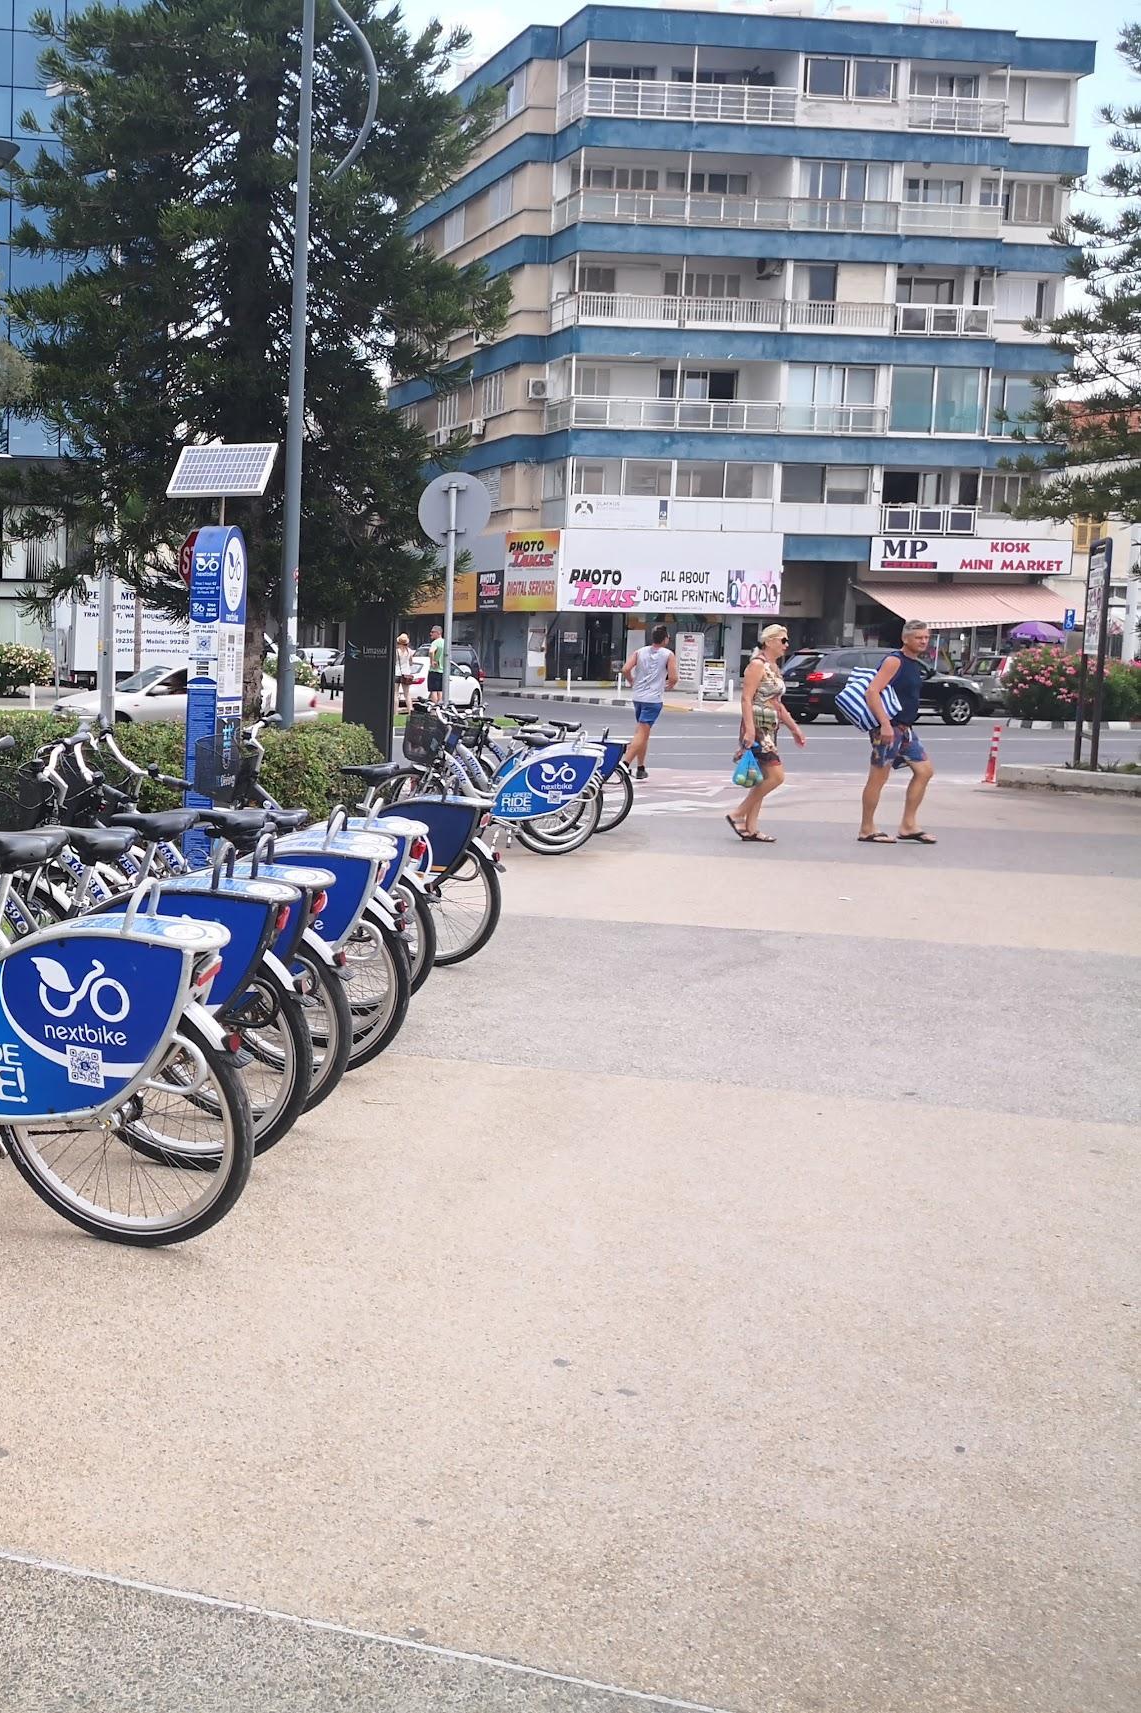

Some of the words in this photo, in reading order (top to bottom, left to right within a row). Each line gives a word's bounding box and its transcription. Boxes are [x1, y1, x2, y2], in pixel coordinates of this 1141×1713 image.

[509, 540, 544, 553] PHOTO
[882, 540, 928, 559] MP
[990, 542, 1030, 553] KIOSK
[511, 552, 554, 568] TAKIS
[960, 559, 993, 571] MINI
[1000, 560, 1063, 572] MARKET
[569, 569, 622, 585] PHOTO
[660, 571, 675, 583] ALL
[679, 571, 710, 585] ABOUT
[574, 580, 637, 608] TAKIS
[501, 797, 532, 807] RIDE
[157, 841, 178, 866] 7663
[44, 1022, 128, 1047] nextbike
